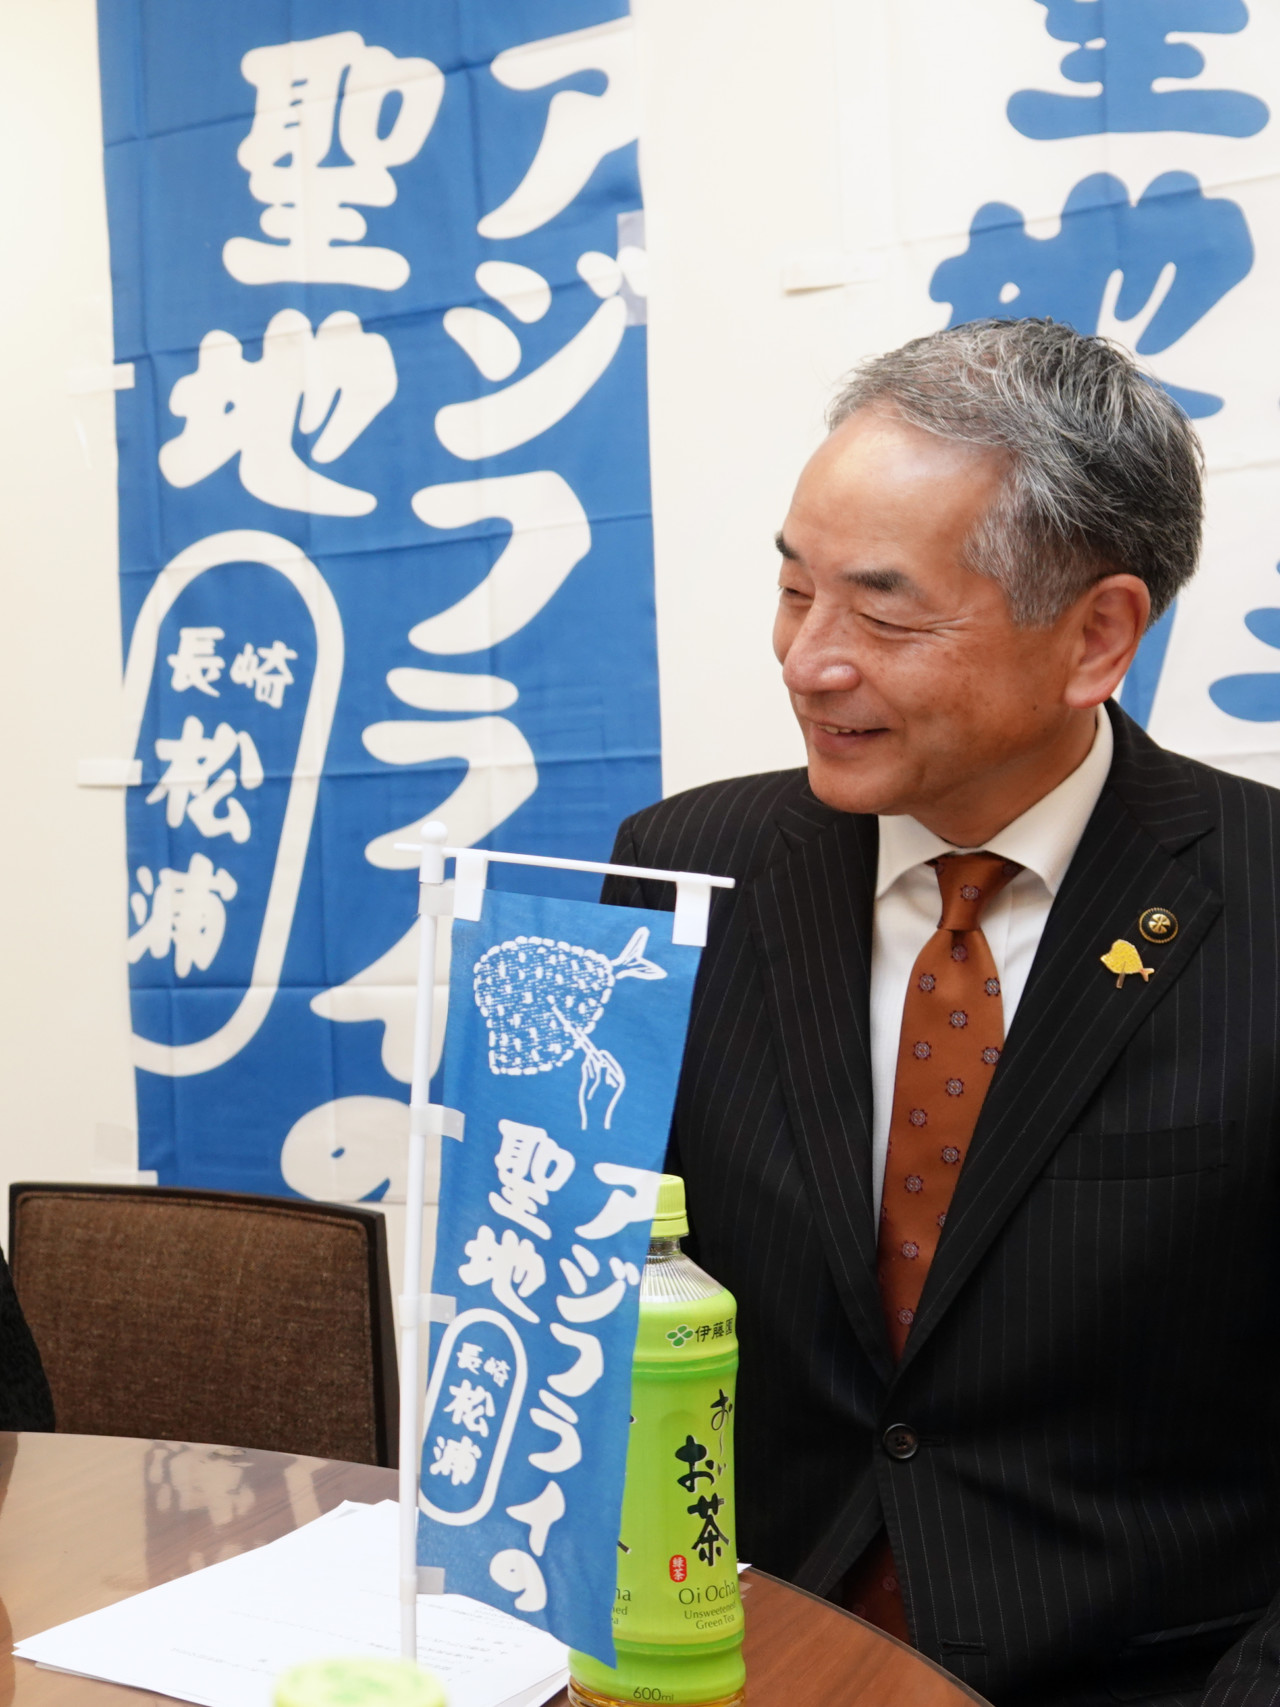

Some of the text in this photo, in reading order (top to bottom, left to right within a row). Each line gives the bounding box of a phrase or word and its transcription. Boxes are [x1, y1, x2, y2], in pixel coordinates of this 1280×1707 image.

[158, 31, 446, 517] 聖地
[167, 626, 298, 708] 長崎
[127, 715, 265, 979] 松浦
[458, 1119, 576, 1324] 聖地
[456, 1342, 511, 1388] 長崎
[489, 1162, 661, 1613] アジフライの
[429, 1379, 496, 1486] 松浦
[674, 1434, 730, 1568] お茶
[678, 1580, 736, 1605] Oi Ocha
[696, 1614, 736, 1630] Green Tea
[633, 1686, 674, 1702] 600ml
